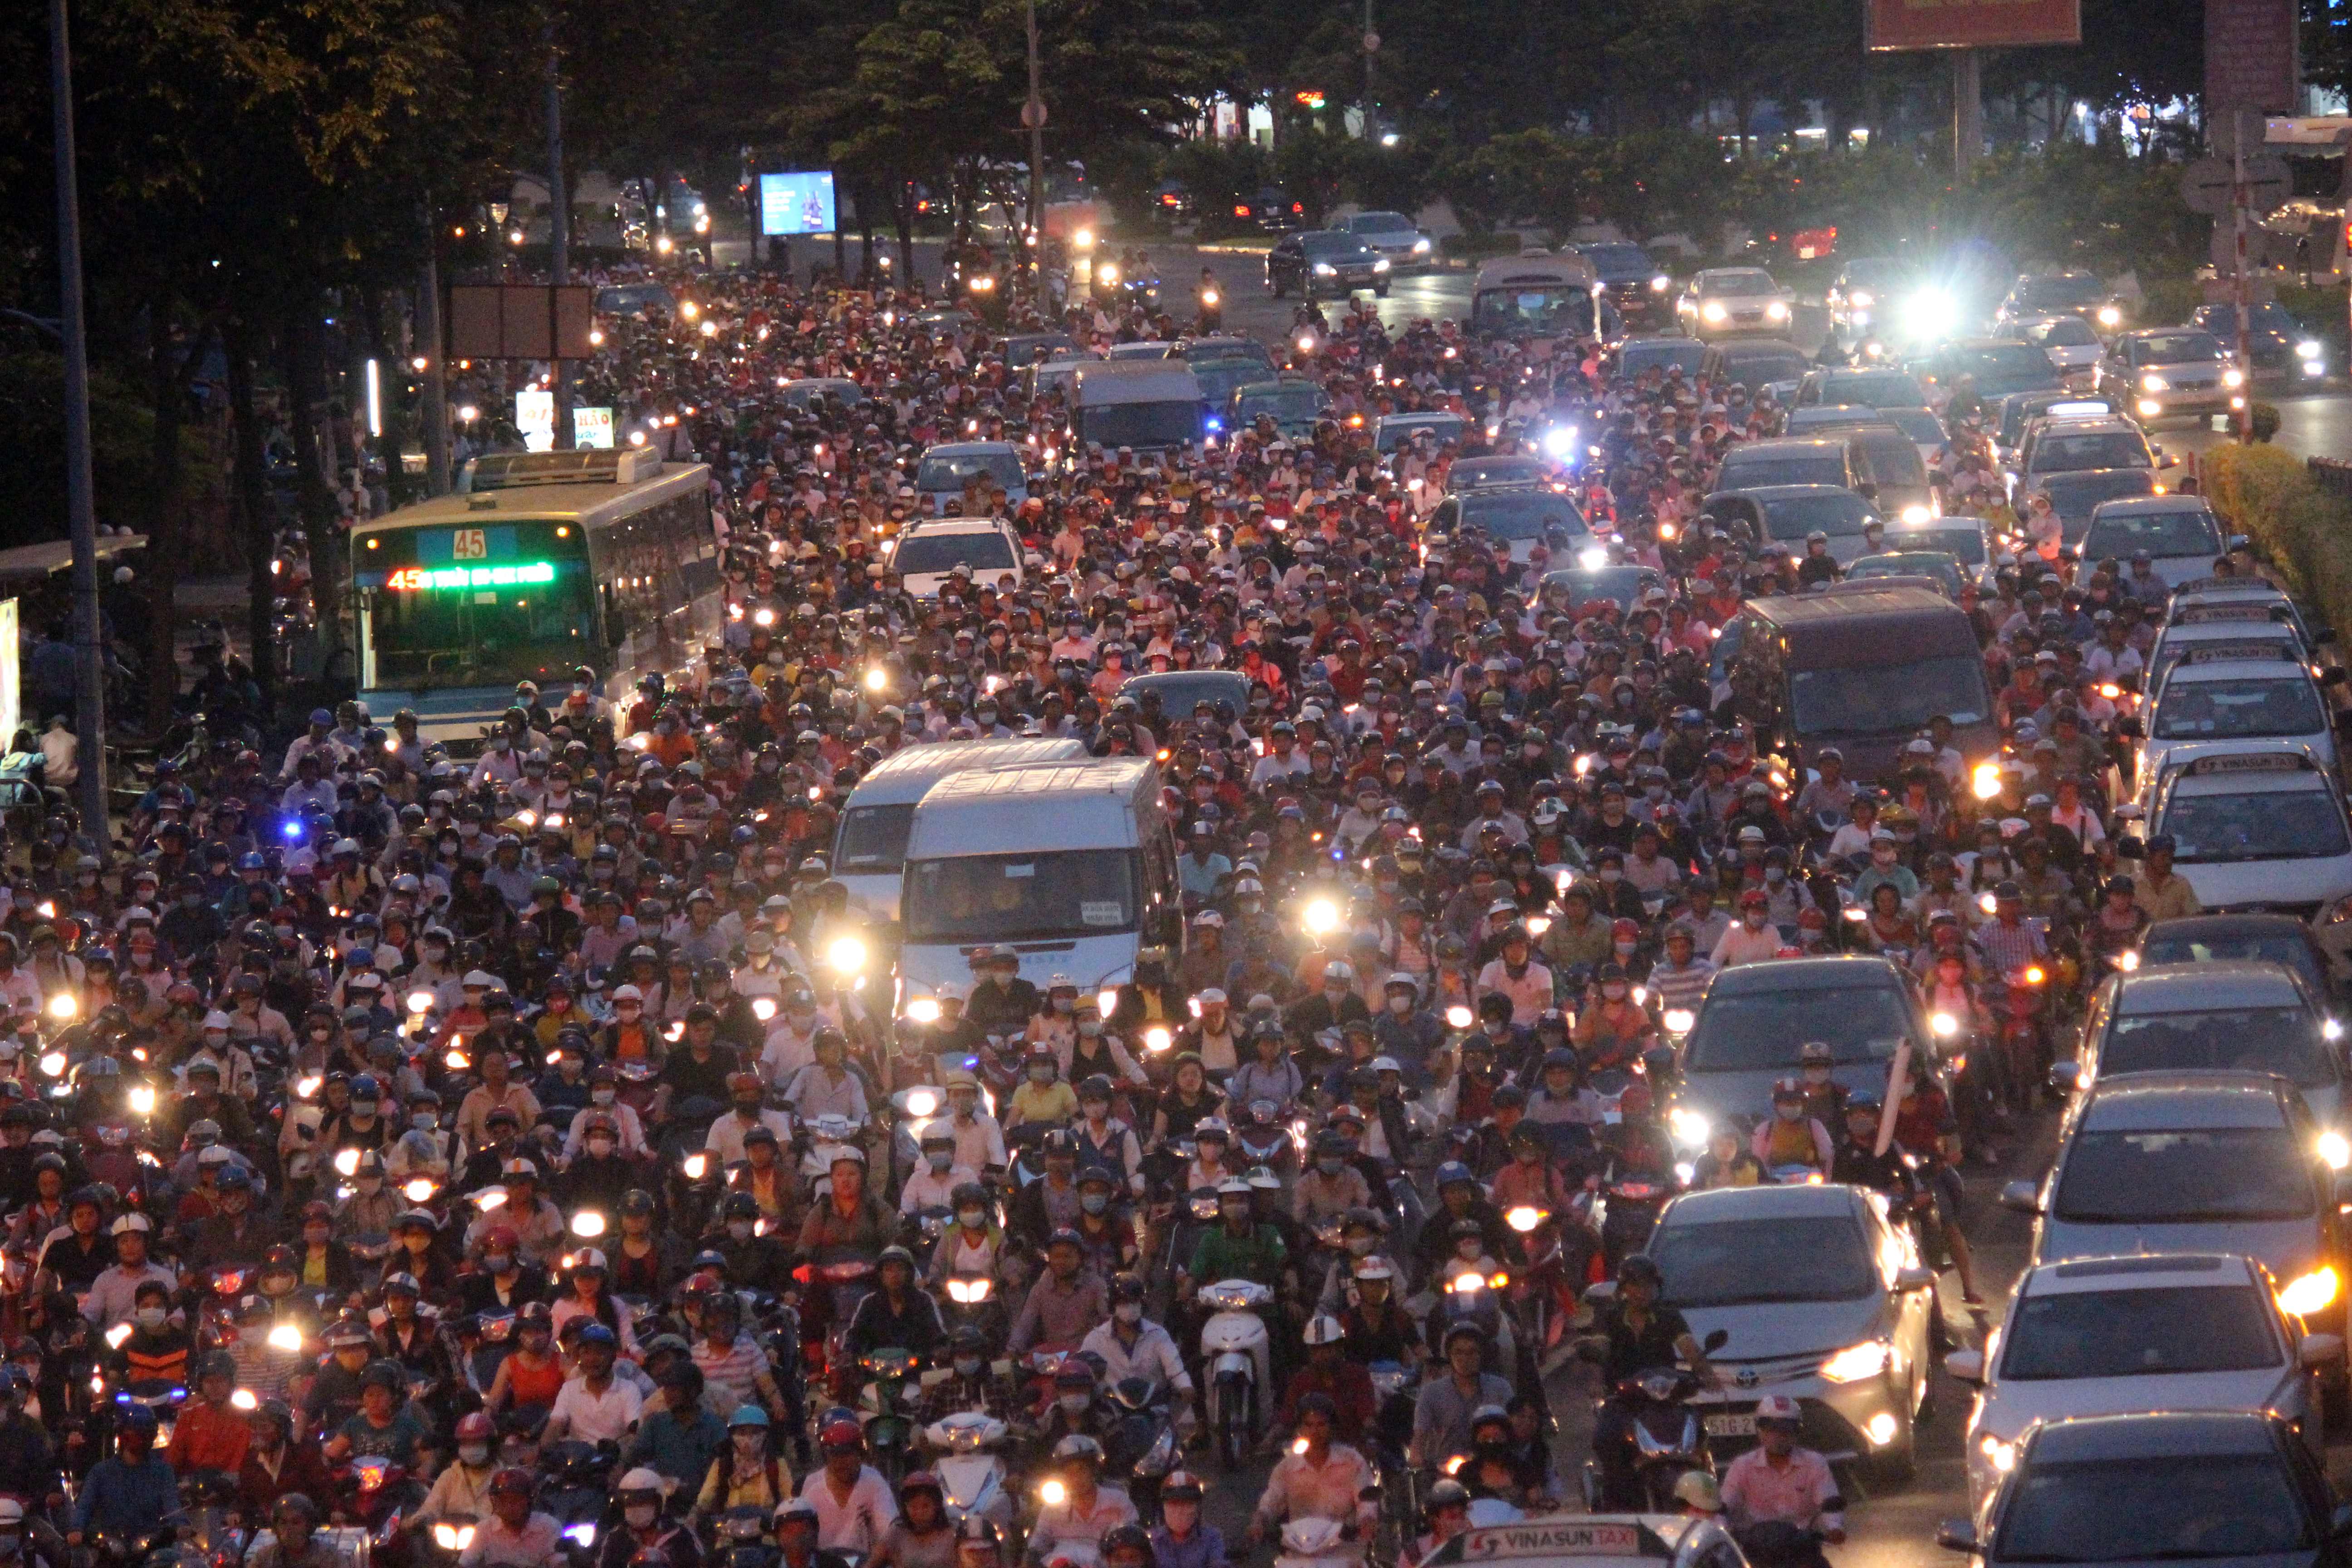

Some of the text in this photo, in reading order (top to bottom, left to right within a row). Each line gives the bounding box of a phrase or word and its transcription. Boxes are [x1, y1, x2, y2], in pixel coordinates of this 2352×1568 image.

[456, 531, 483, 558] 45
[1505, 1529, 1634, 1547] VINASUN TAXI
